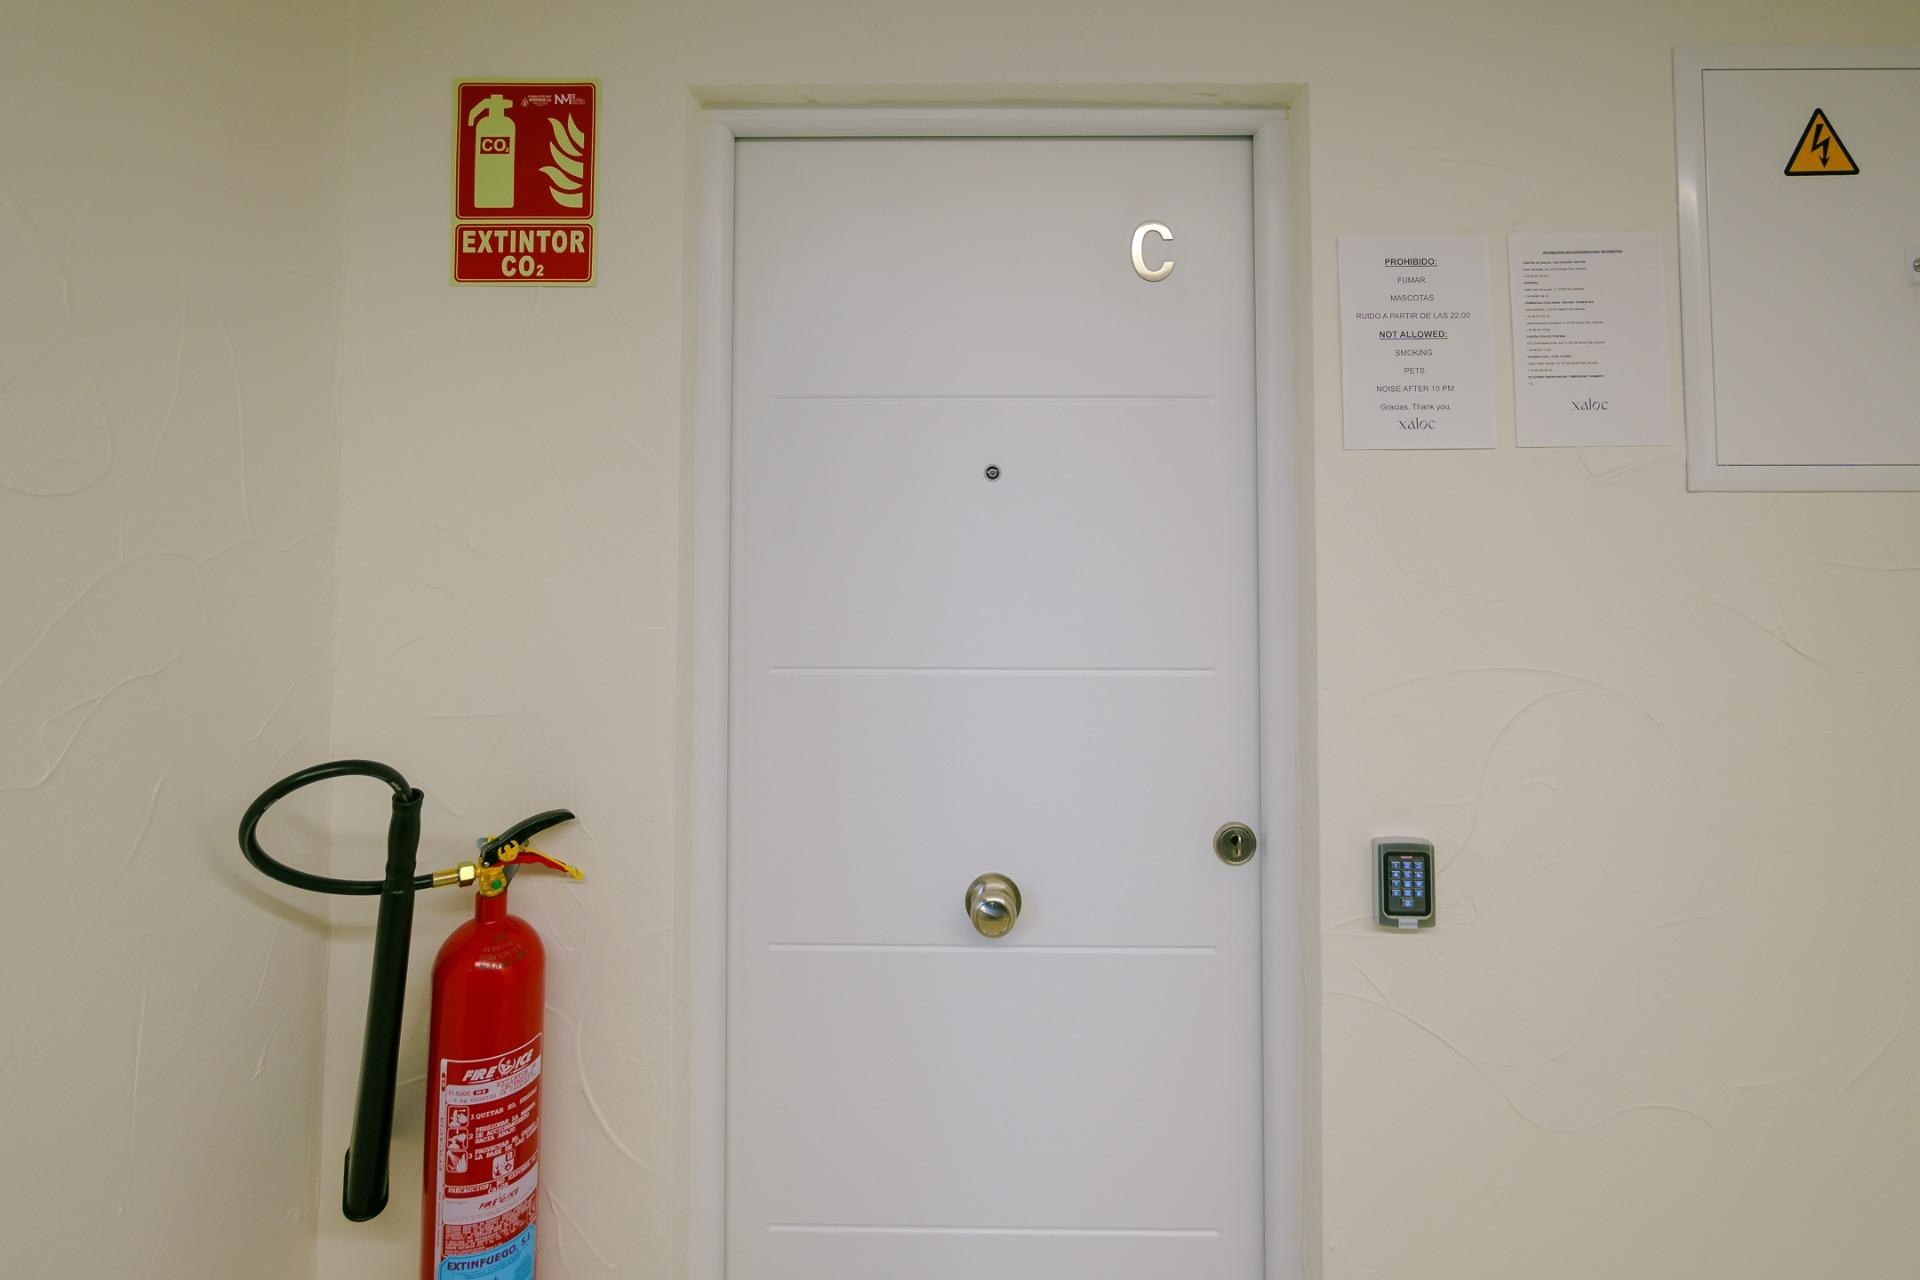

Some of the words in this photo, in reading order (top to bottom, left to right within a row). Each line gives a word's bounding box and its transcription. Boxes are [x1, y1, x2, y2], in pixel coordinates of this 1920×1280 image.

[462, 230, 585, 254] EXTINTOR
[1131, 220, 1175, 282] C
[1384, 257, 1438, 267] PROHIBIDO:
[1397, 276, 1426, 284] FUMAR
[1390, 294, 1434, 302] MASCOTAS
[1356, 312, 1381, 320] RUIDO
[1450, 311, 1471, 319] 22:00
[1379, 331, 1397, 340] NOT
[1400, 330, 1448, 339] ALLOWED:
[1395, 349, 1433, 357] SMOKING
[1404, 367, 1425, 375] PETS
[1376, 385, 1401, 393] NOISE
[1436, 403, 1453, 413] you.
[1571, 398, 1609, 411] xaloc
[1398, 417, 1436, 430] xaloc
[461, 1065, 498, 1082] FIRE
